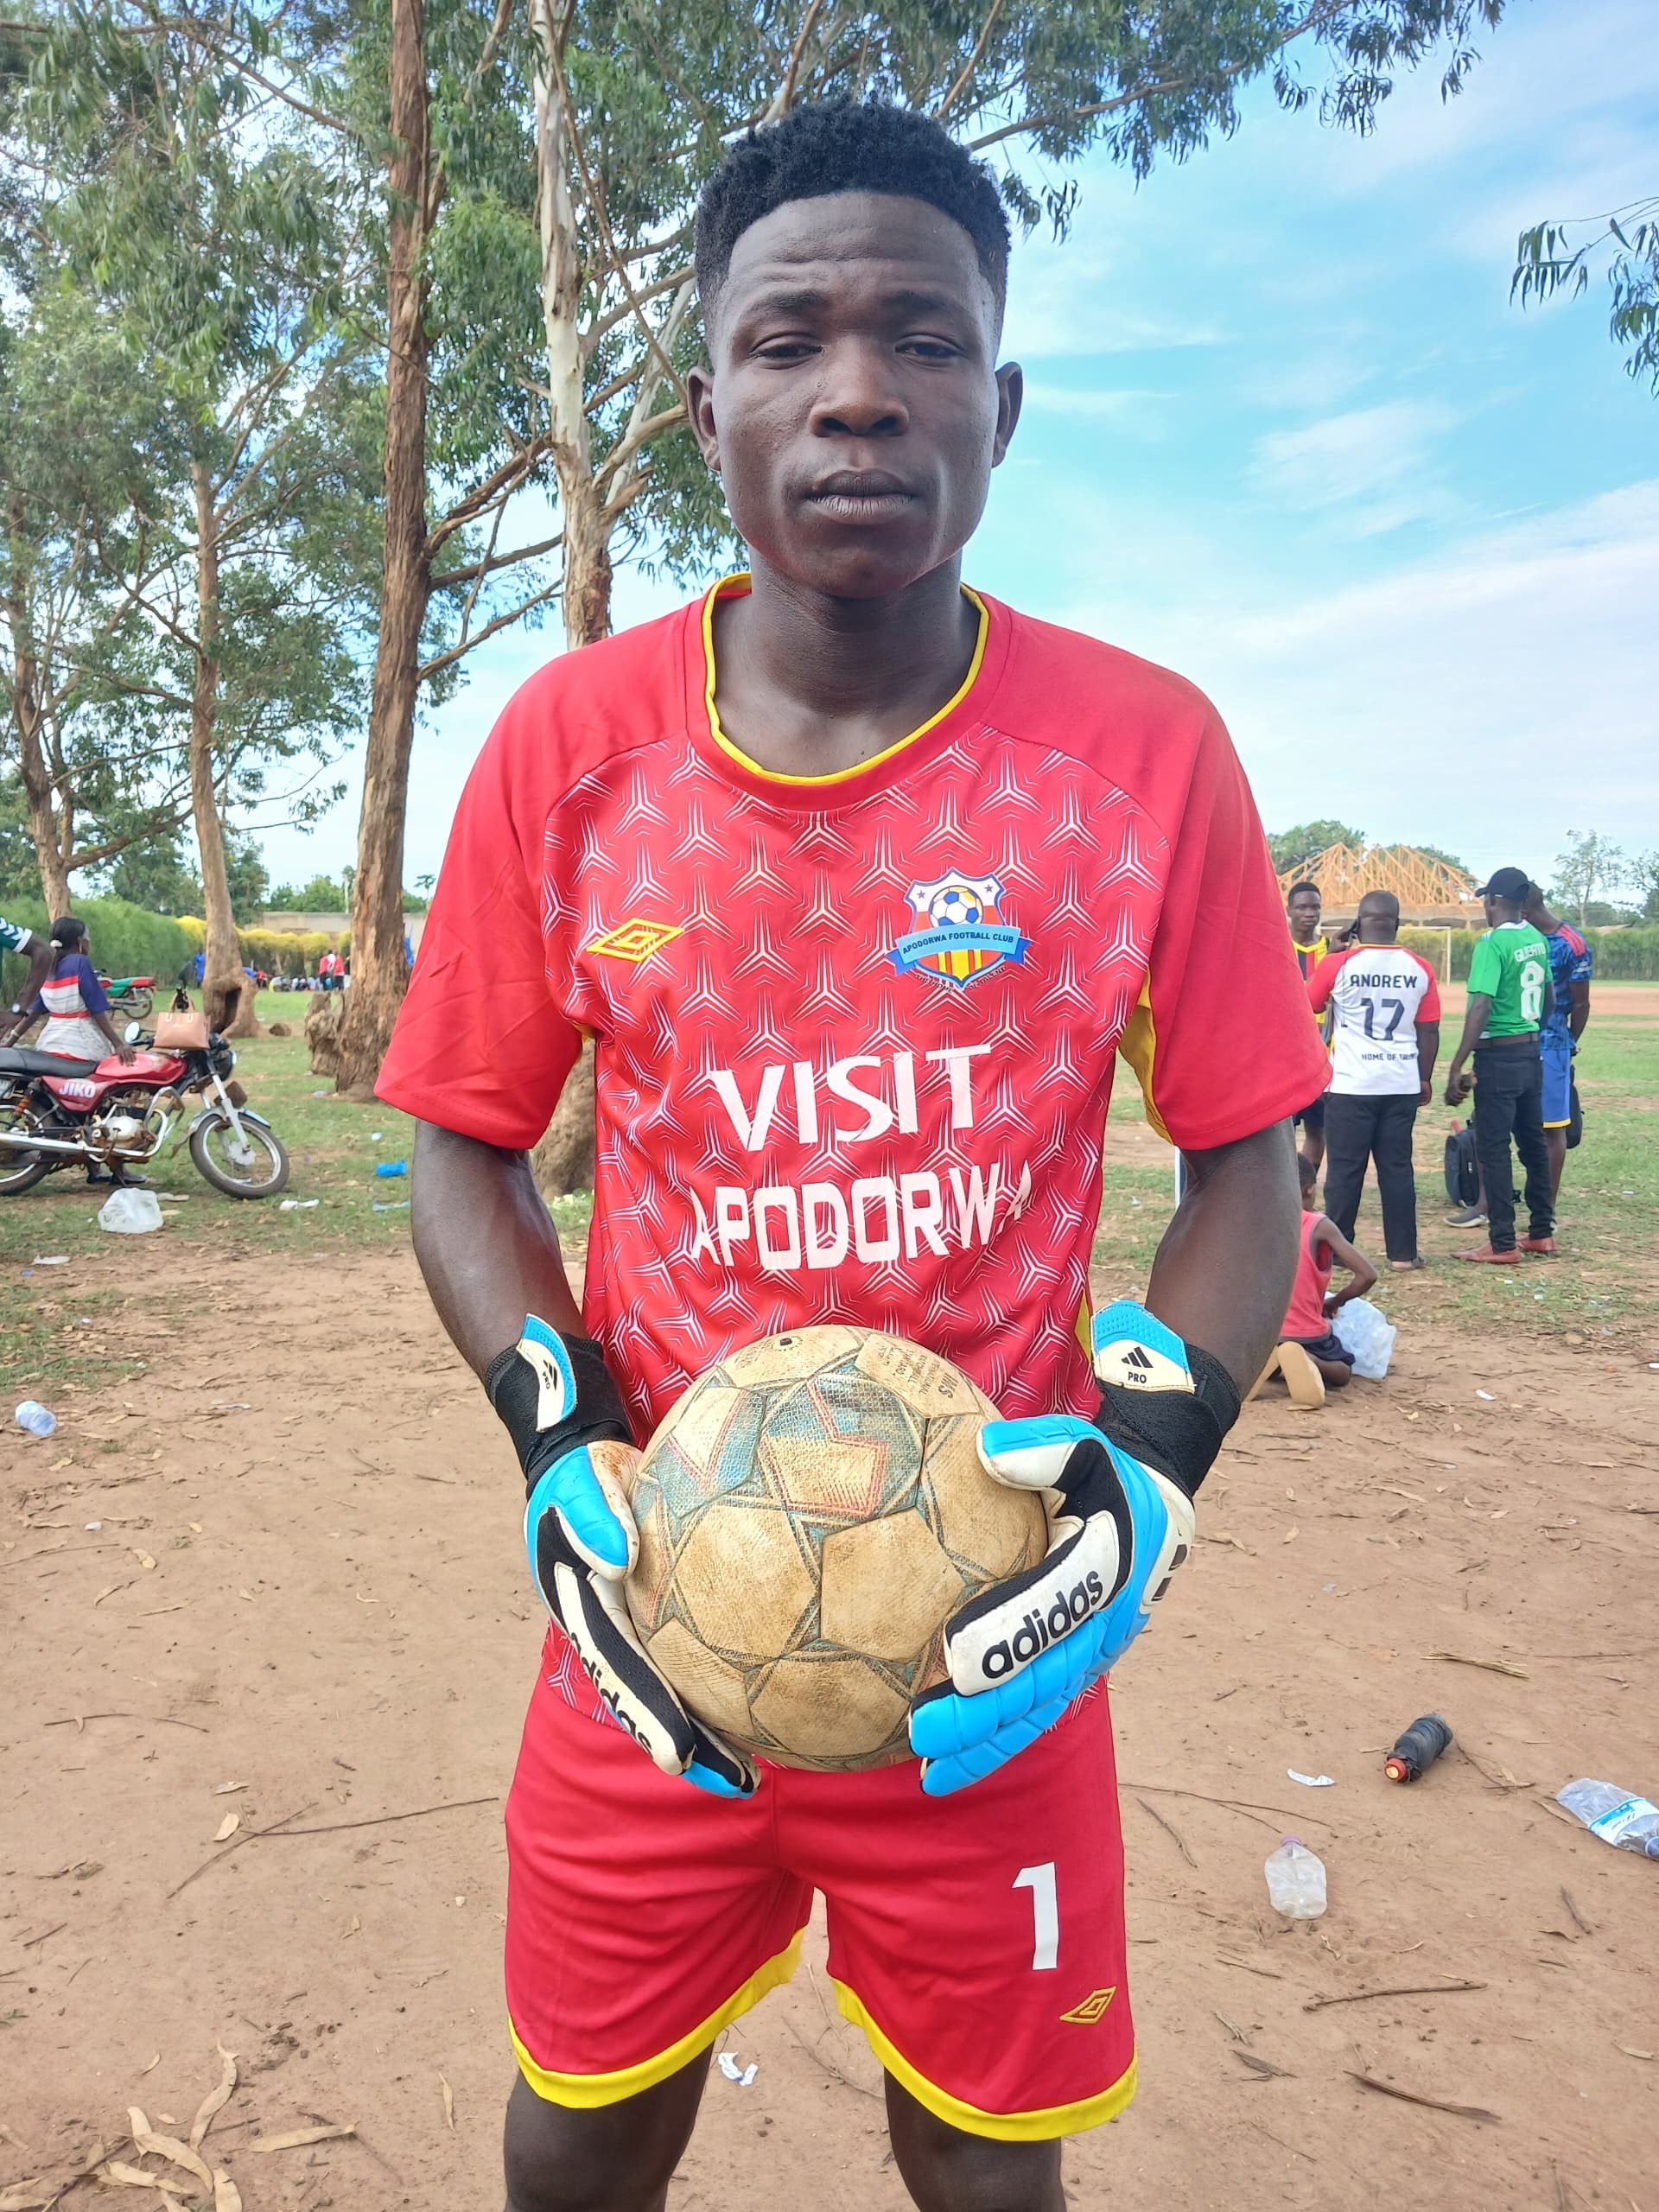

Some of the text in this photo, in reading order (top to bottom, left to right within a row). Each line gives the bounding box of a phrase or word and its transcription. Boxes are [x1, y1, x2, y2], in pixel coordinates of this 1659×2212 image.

[903, 931, 1014, 954] APODORWA FOOTBALL CLUB
[932, 981, 953, 993] HOME
[1351, 974, 1417, 988] ANDREW
[1521, 960, 1545, 1020] 8
[1360, 998, 1405, 1041] 17
[59, 1082, 96, 1098] JIKO
[710, 1043, 991, 1152] VISIT
[690, 1160, 1032, 1271] APODORWA
[1128, 1371, 1147, 1383] PRO
[982, 1569, 1103, 1680] adidas
[1012, 1861, 1059, 1970] 1
